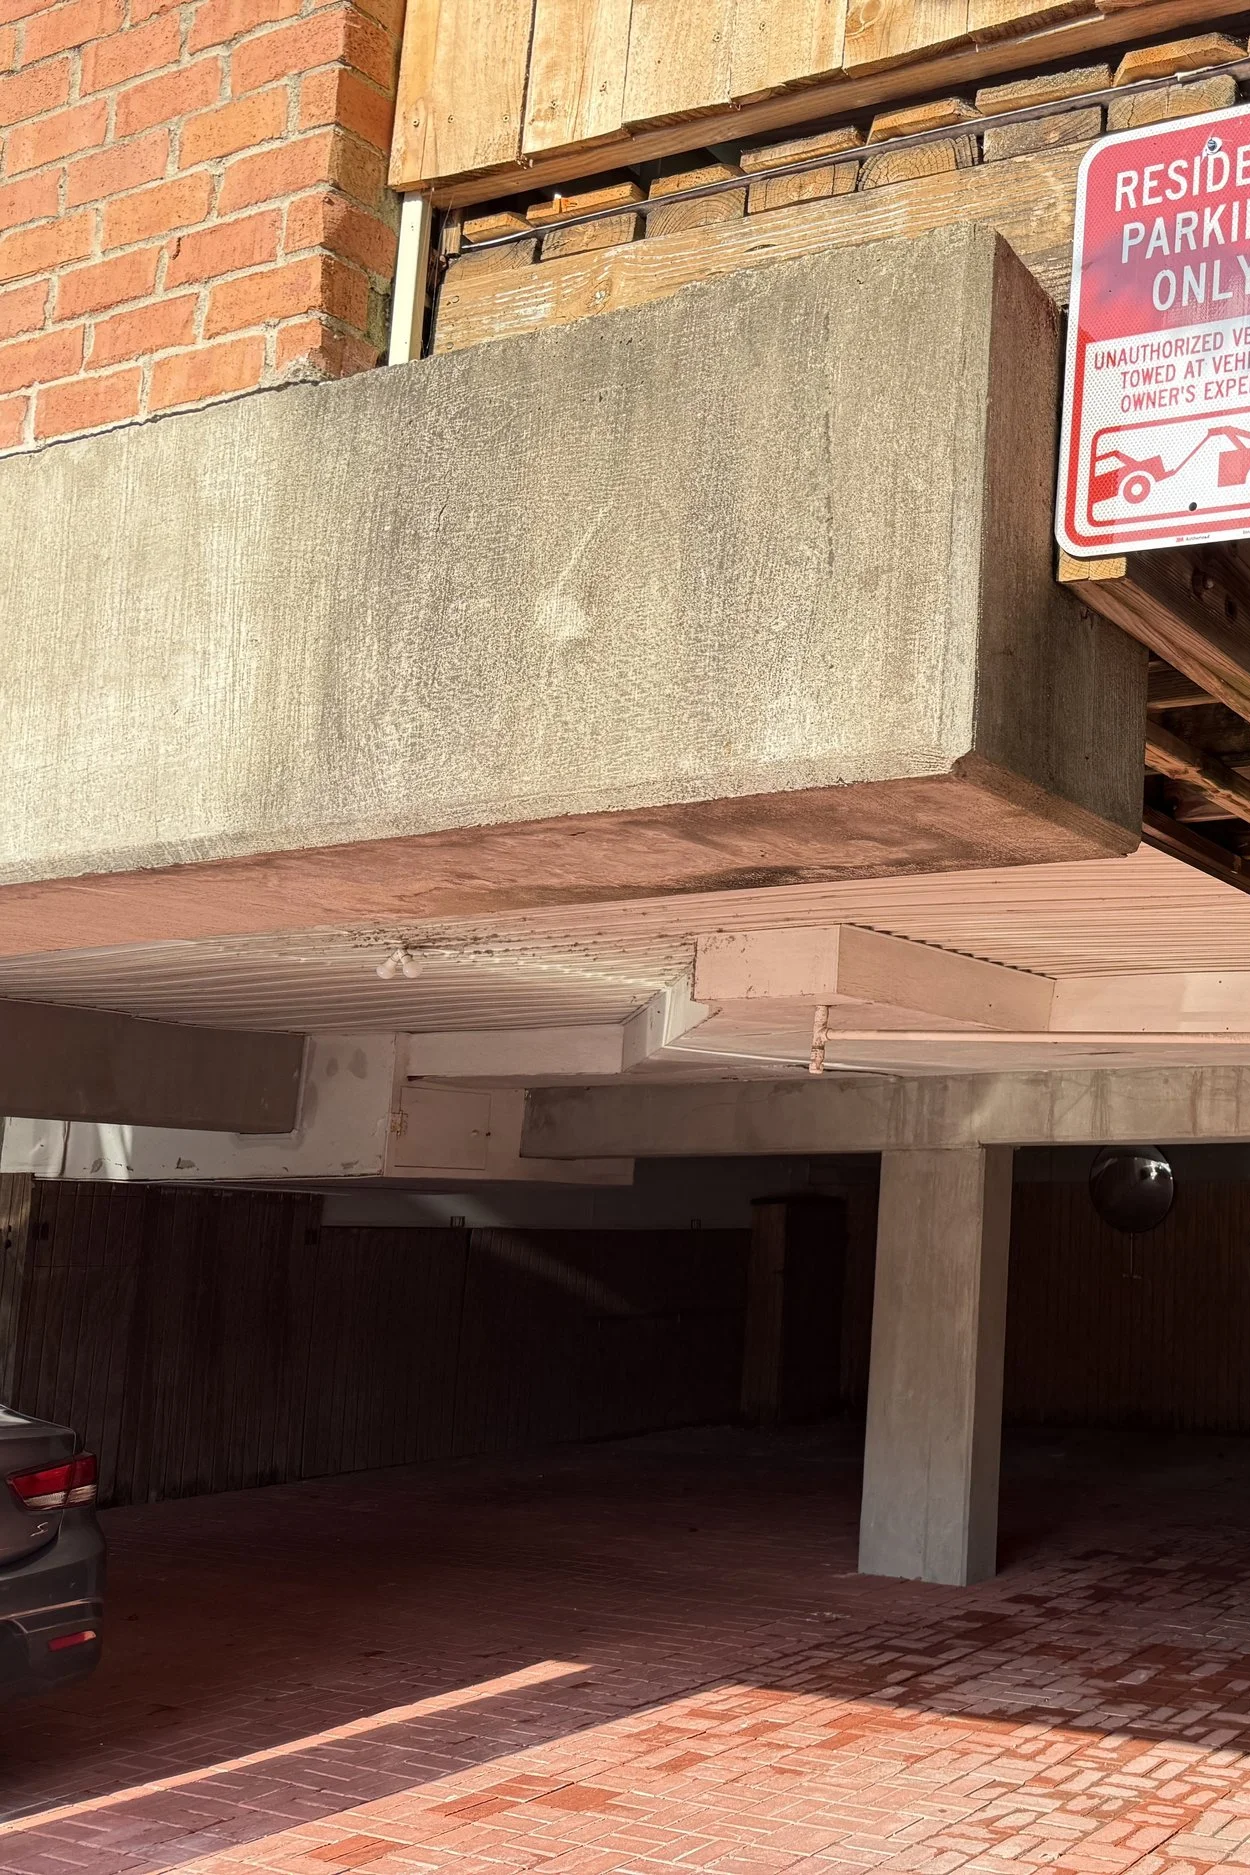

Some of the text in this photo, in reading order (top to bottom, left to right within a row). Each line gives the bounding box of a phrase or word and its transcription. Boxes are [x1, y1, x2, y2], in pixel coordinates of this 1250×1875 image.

[1094, 331, 1225, 370] UNAUTHORIZED
[1121, 364, 1176, 389] TOWED
[1184, 359, 1207, 379] AT
[1121, 385, 1195, 413] OWNER'S
